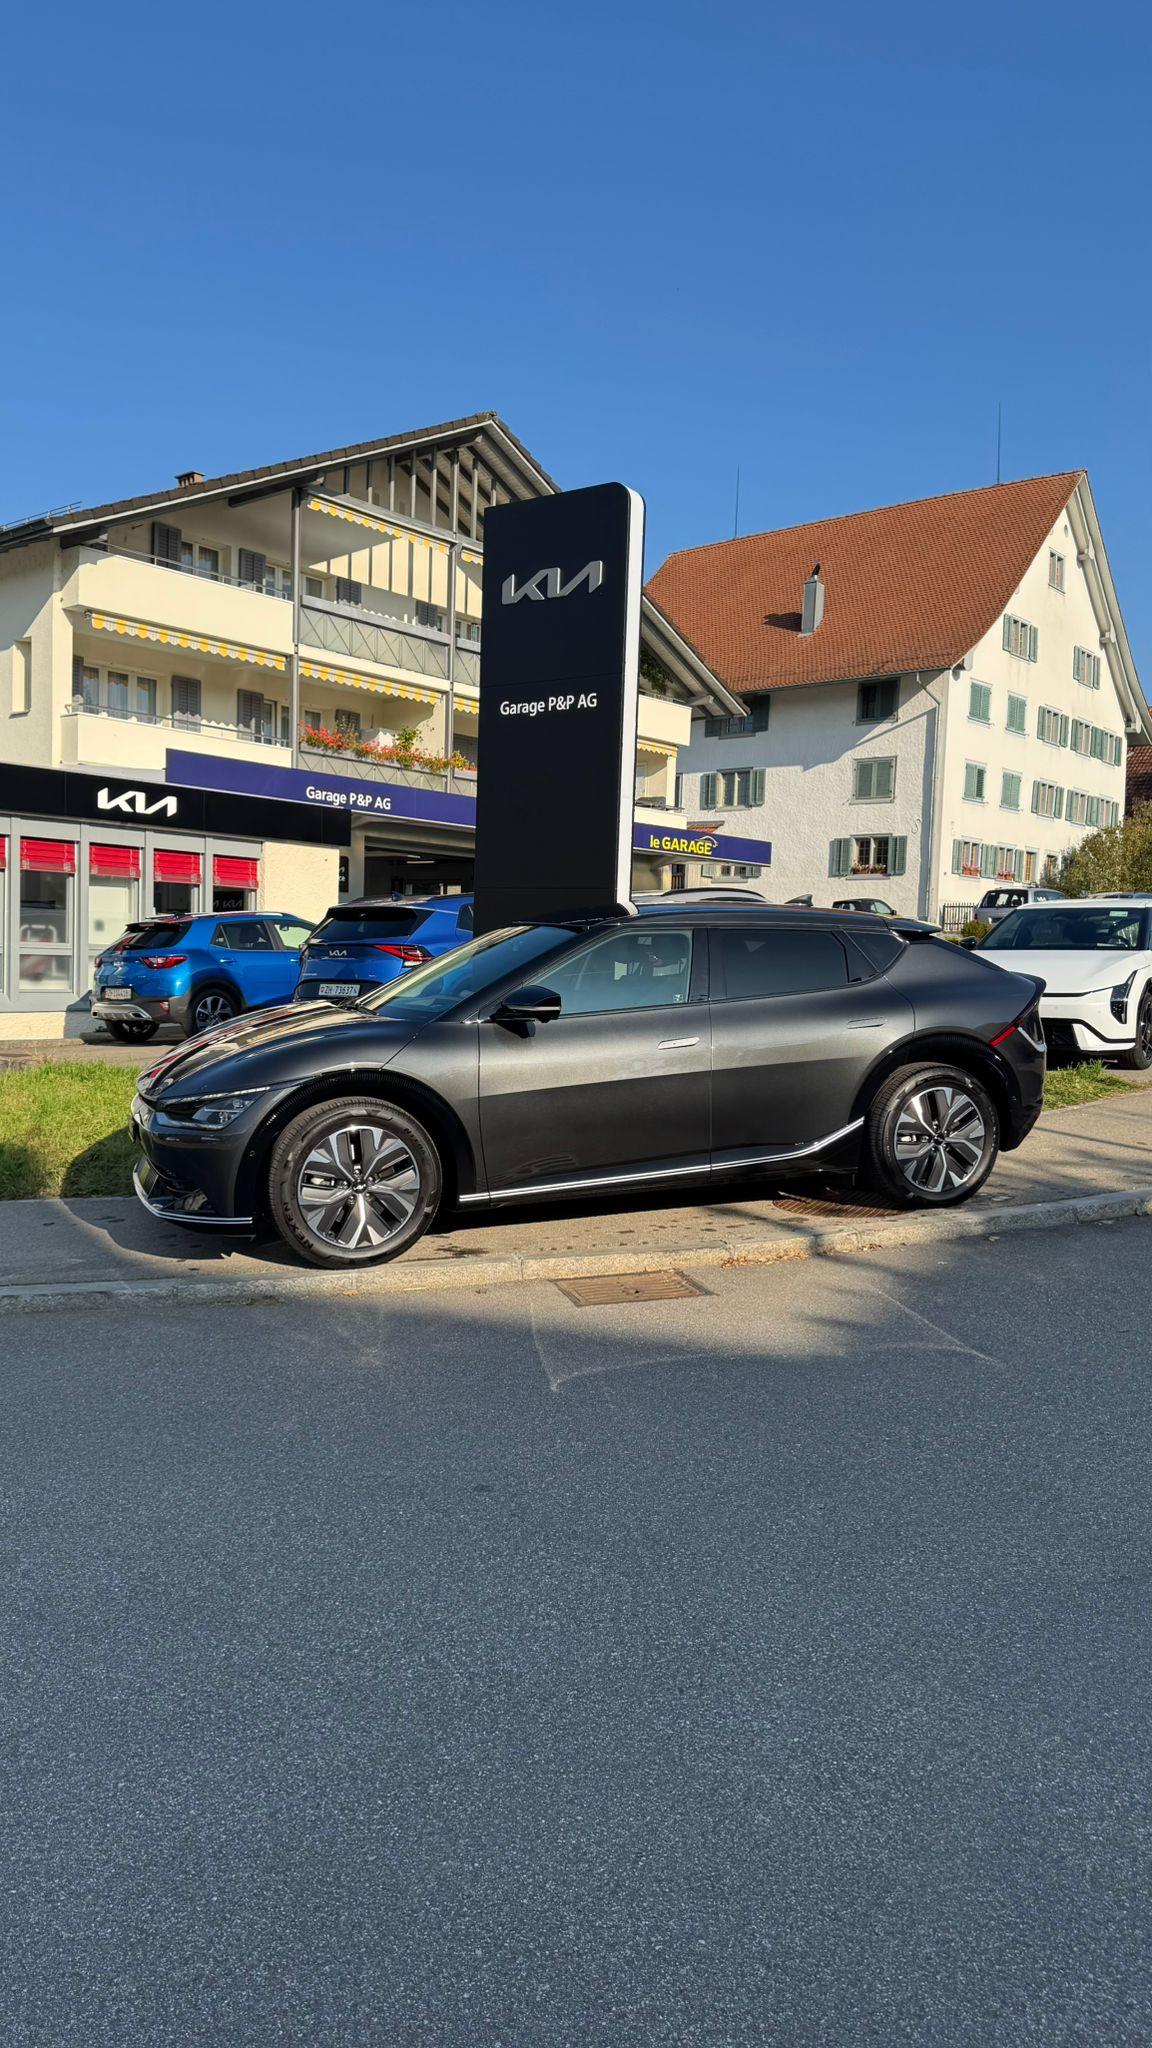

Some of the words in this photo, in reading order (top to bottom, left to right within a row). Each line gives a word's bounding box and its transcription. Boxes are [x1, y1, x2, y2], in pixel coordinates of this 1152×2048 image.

[502, 560, 603, 605] KIA
[500, 701, 545, 716] Garage
[548, 695, 575, 711] P&P
[577, 693, 597, 709] AG
[97, 787, 177, 817] KIA
[306, 786, 347, 806] Garage
[349, 793, 372, 807] P&P
[374, 796, 391, 810] AG
[650, 834, 660, 848] le
[662, 836, 712, 855] GARAGE
[328, 949, 347, 957] KIA
